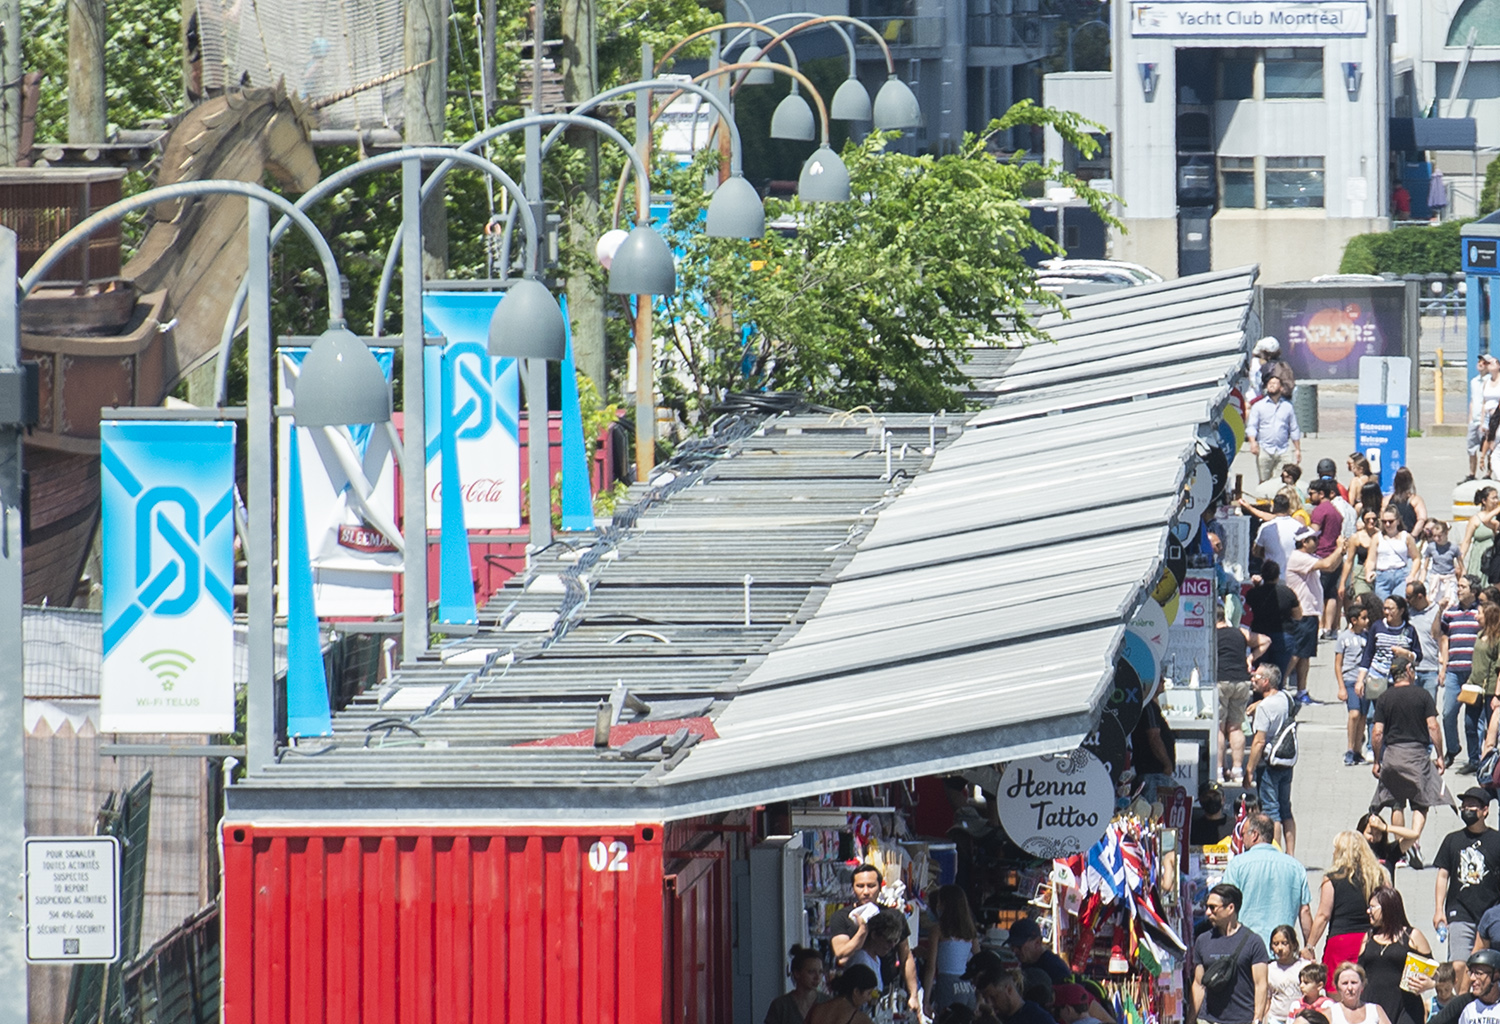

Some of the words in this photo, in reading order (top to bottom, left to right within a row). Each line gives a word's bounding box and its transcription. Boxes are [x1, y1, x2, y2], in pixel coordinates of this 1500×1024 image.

[1177, 11, 1222, 25] Yacht
[1227, 11, 1263, 25] Club
[1270, 10, 1344, 25] Montréal
[1289, 324, 1376, 343] EXPLORE
[431, 478, 505, 503] CCola
[341, 529, 393, 547] SLEEMA
[166, 697, 200, 707] TELUS
[1007, 768, 1086, 798] Henna
[1030, 800, 1098, 830] Tattoo
[46, 850, 63, 858] POUR
[65, 850, 96, 858] SIGNALER
[588, 841, 629, 872] 02
[43, 861, 66, 870] TOUTES
[53, 872, 89, 881] SUSPECTES
[54, 884, 62, 892] TO
[64, 884, 88, 892] REPORT
[35, 896, 71, 905] SUSPICIOUS
[73, 896, 107, 904] ACTIVITIES
[37, 924, 67, 934] SÉCURITÉ
[76, 925, 105, 934] SECURITY
